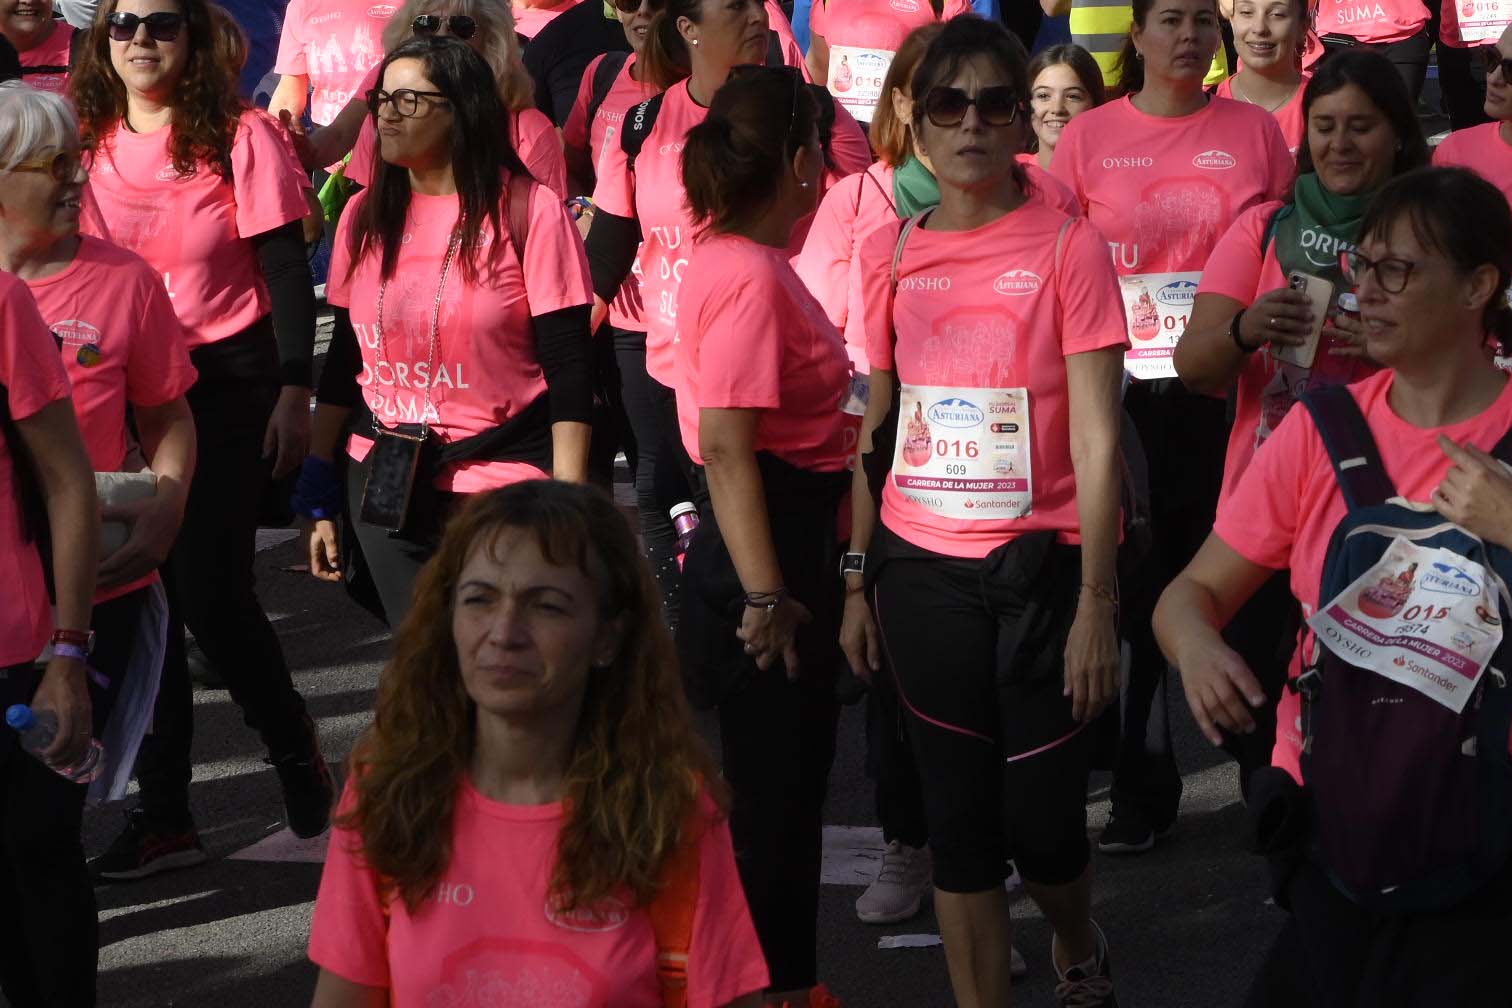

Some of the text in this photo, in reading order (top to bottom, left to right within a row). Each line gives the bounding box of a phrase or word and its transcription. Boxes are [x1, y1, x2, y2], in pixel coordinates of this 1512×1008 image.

[1337, 3, 1386, 25] SUMA
[1102, 156, 1153, 169] OYSHO
[1195, 157, 1233, 167] ASTURIANA
[651, 226, 681, 249] TU
[1108, 241, 1138, 268] TU
[900, 276, 951, 291] OYSHO
[997, 279, 1039, 290] ASTURIANA
[1138, 348, 1172, 358] CARRERA
[932, 409, 980, 422] ASTURIANA
[989, 406, 1017, 414] SUMA
[935, 439, 979, 458] 016
[946, 464, 967, 475] 609
[907, 479, 941, 488] CARRERA
[966, 481, 994, 489] MUJER
[975, 499, 1020, 509] Santander
[1325, 626, 1371, 659] OYSHO
[1343, 618, 1385, 644] CARRERA
[1409, 638, 1441, 657] MUJER
[1441, 653, 1466, 669] 2023
[1407, 660, 1458, 691] Santander
